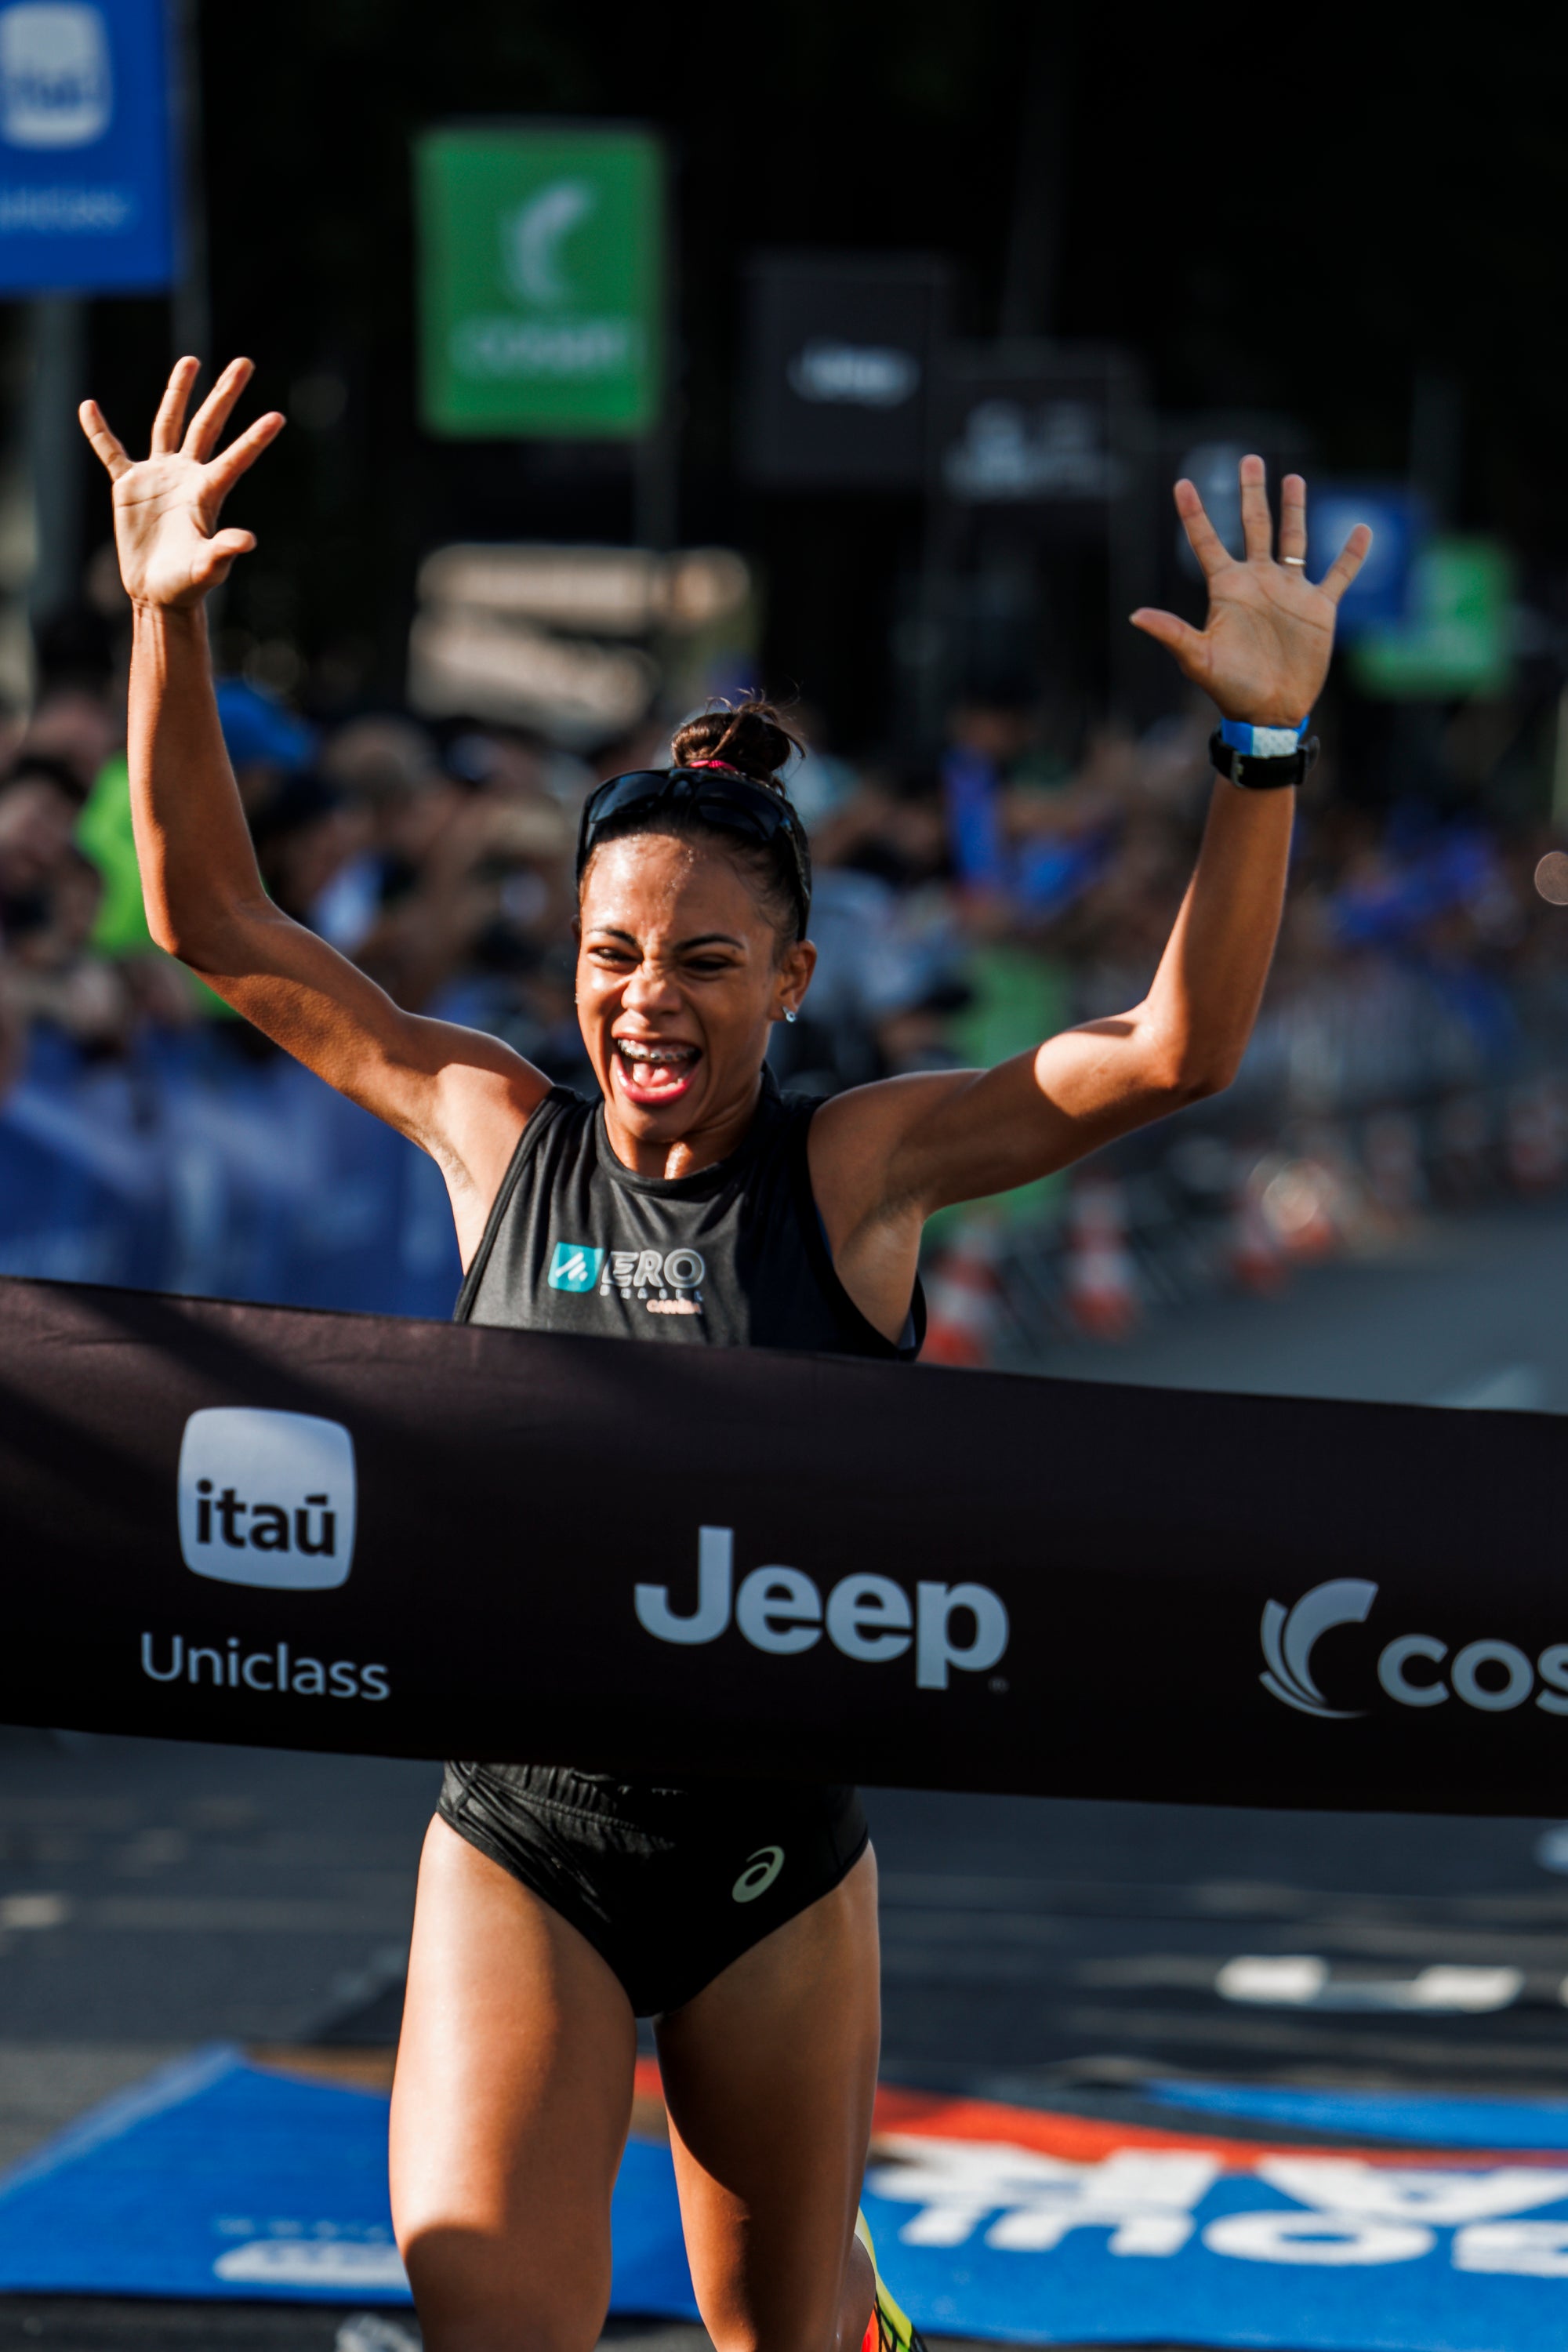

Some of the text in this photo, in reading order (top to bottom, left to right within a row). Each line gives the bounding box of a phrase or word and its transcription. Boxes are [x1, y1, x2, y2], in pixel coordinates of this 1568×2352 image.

[196, 1479, 336, 1557] itaú
[634, 1525, 1009, 1690] Jeep
[141, 1632, 390, 1700] Uniclass
